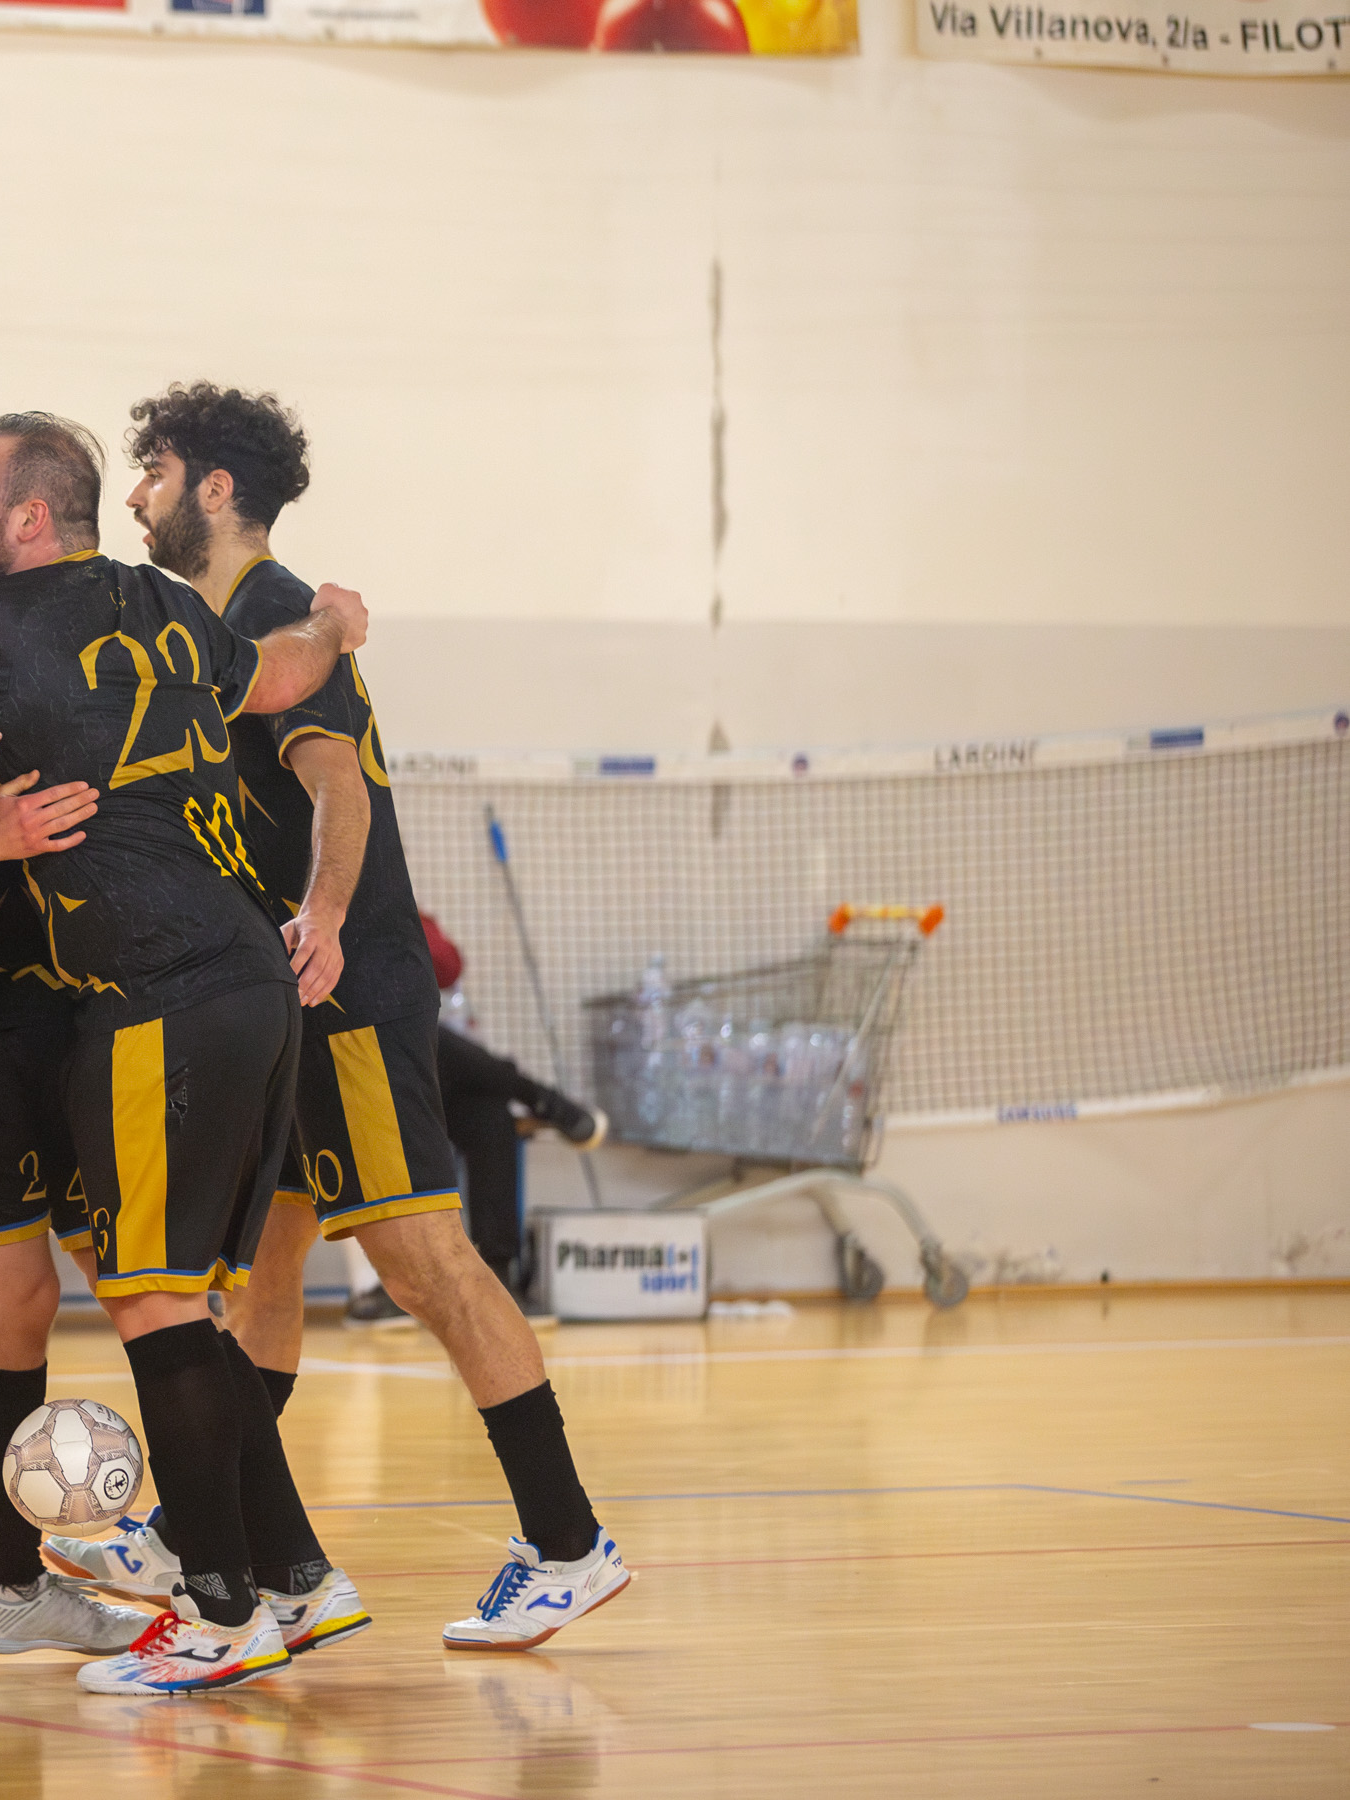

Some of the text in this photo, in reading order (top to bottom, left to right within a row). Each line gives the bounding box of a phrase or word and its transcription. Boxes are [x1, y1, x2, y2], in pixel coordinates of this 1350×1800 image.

[930, 1, 976, 37] Via
[989, 5, 1158, 48] Villanova,
[1166, 14, 1209, 51] 2/a
[78, 620, 231, 790] 23
[302, 1148, 344, 1206] 80
